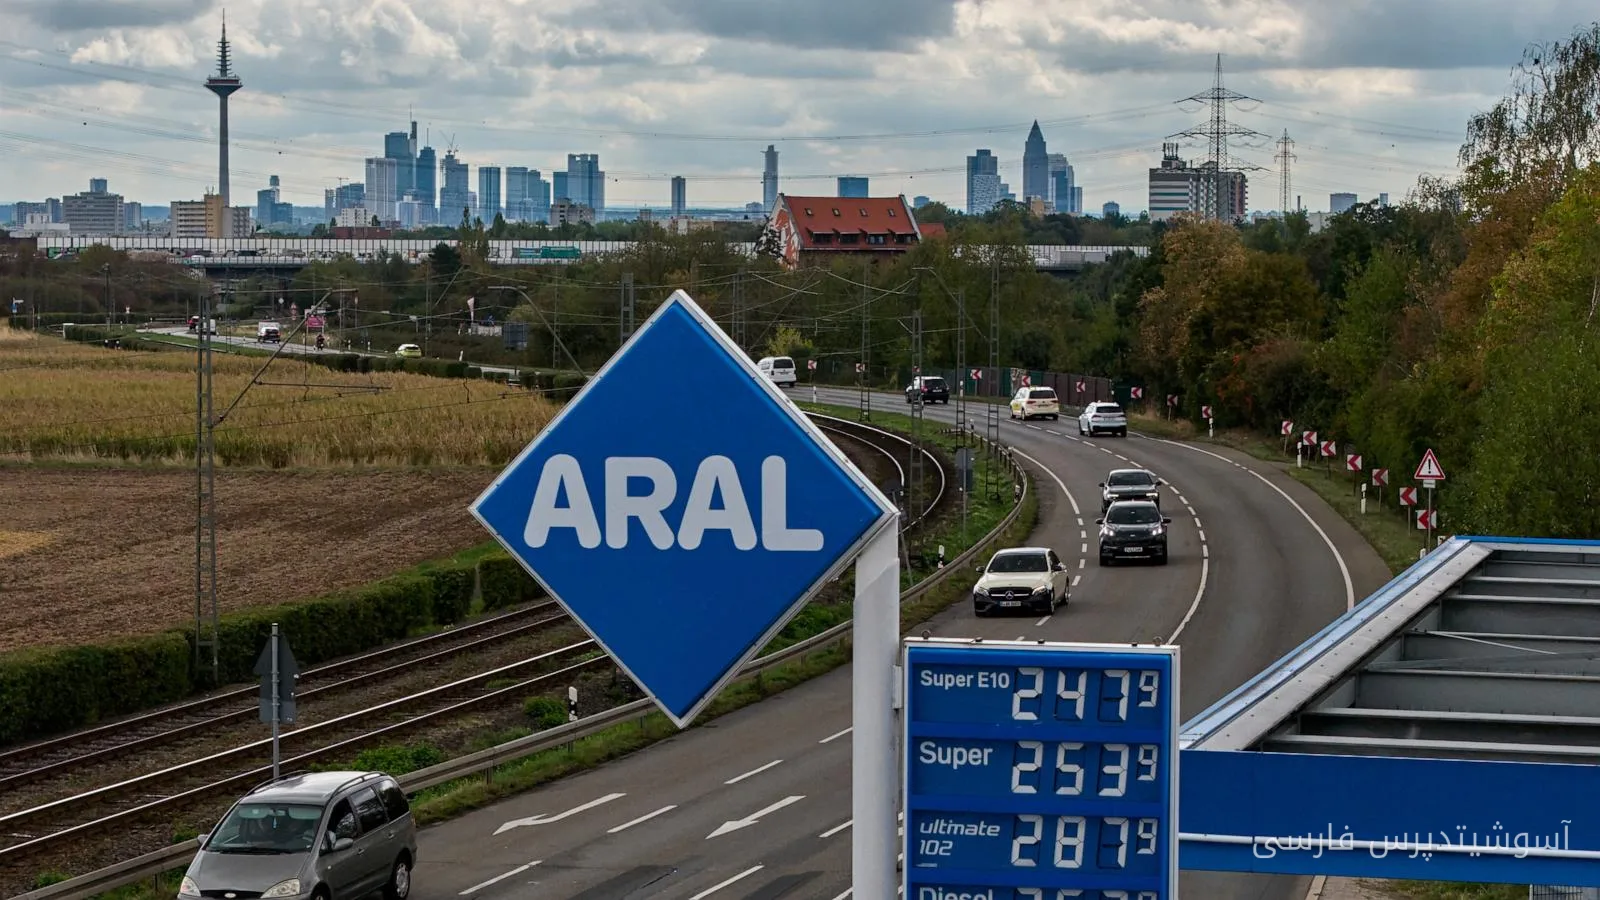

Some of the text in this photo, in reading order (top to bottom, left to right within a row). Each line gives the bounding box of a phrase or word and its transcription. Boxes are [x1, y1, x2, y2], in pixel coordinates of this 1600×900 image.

[523, 453, 825, 552] ARAL
[920, 669, 974, 690] Super
[978, 671, 1010, 688] E10
[919, 741, 993, 770] Super
[919, 819, 1001, 837] ultimate
[919, 839, 954, 856] 102
